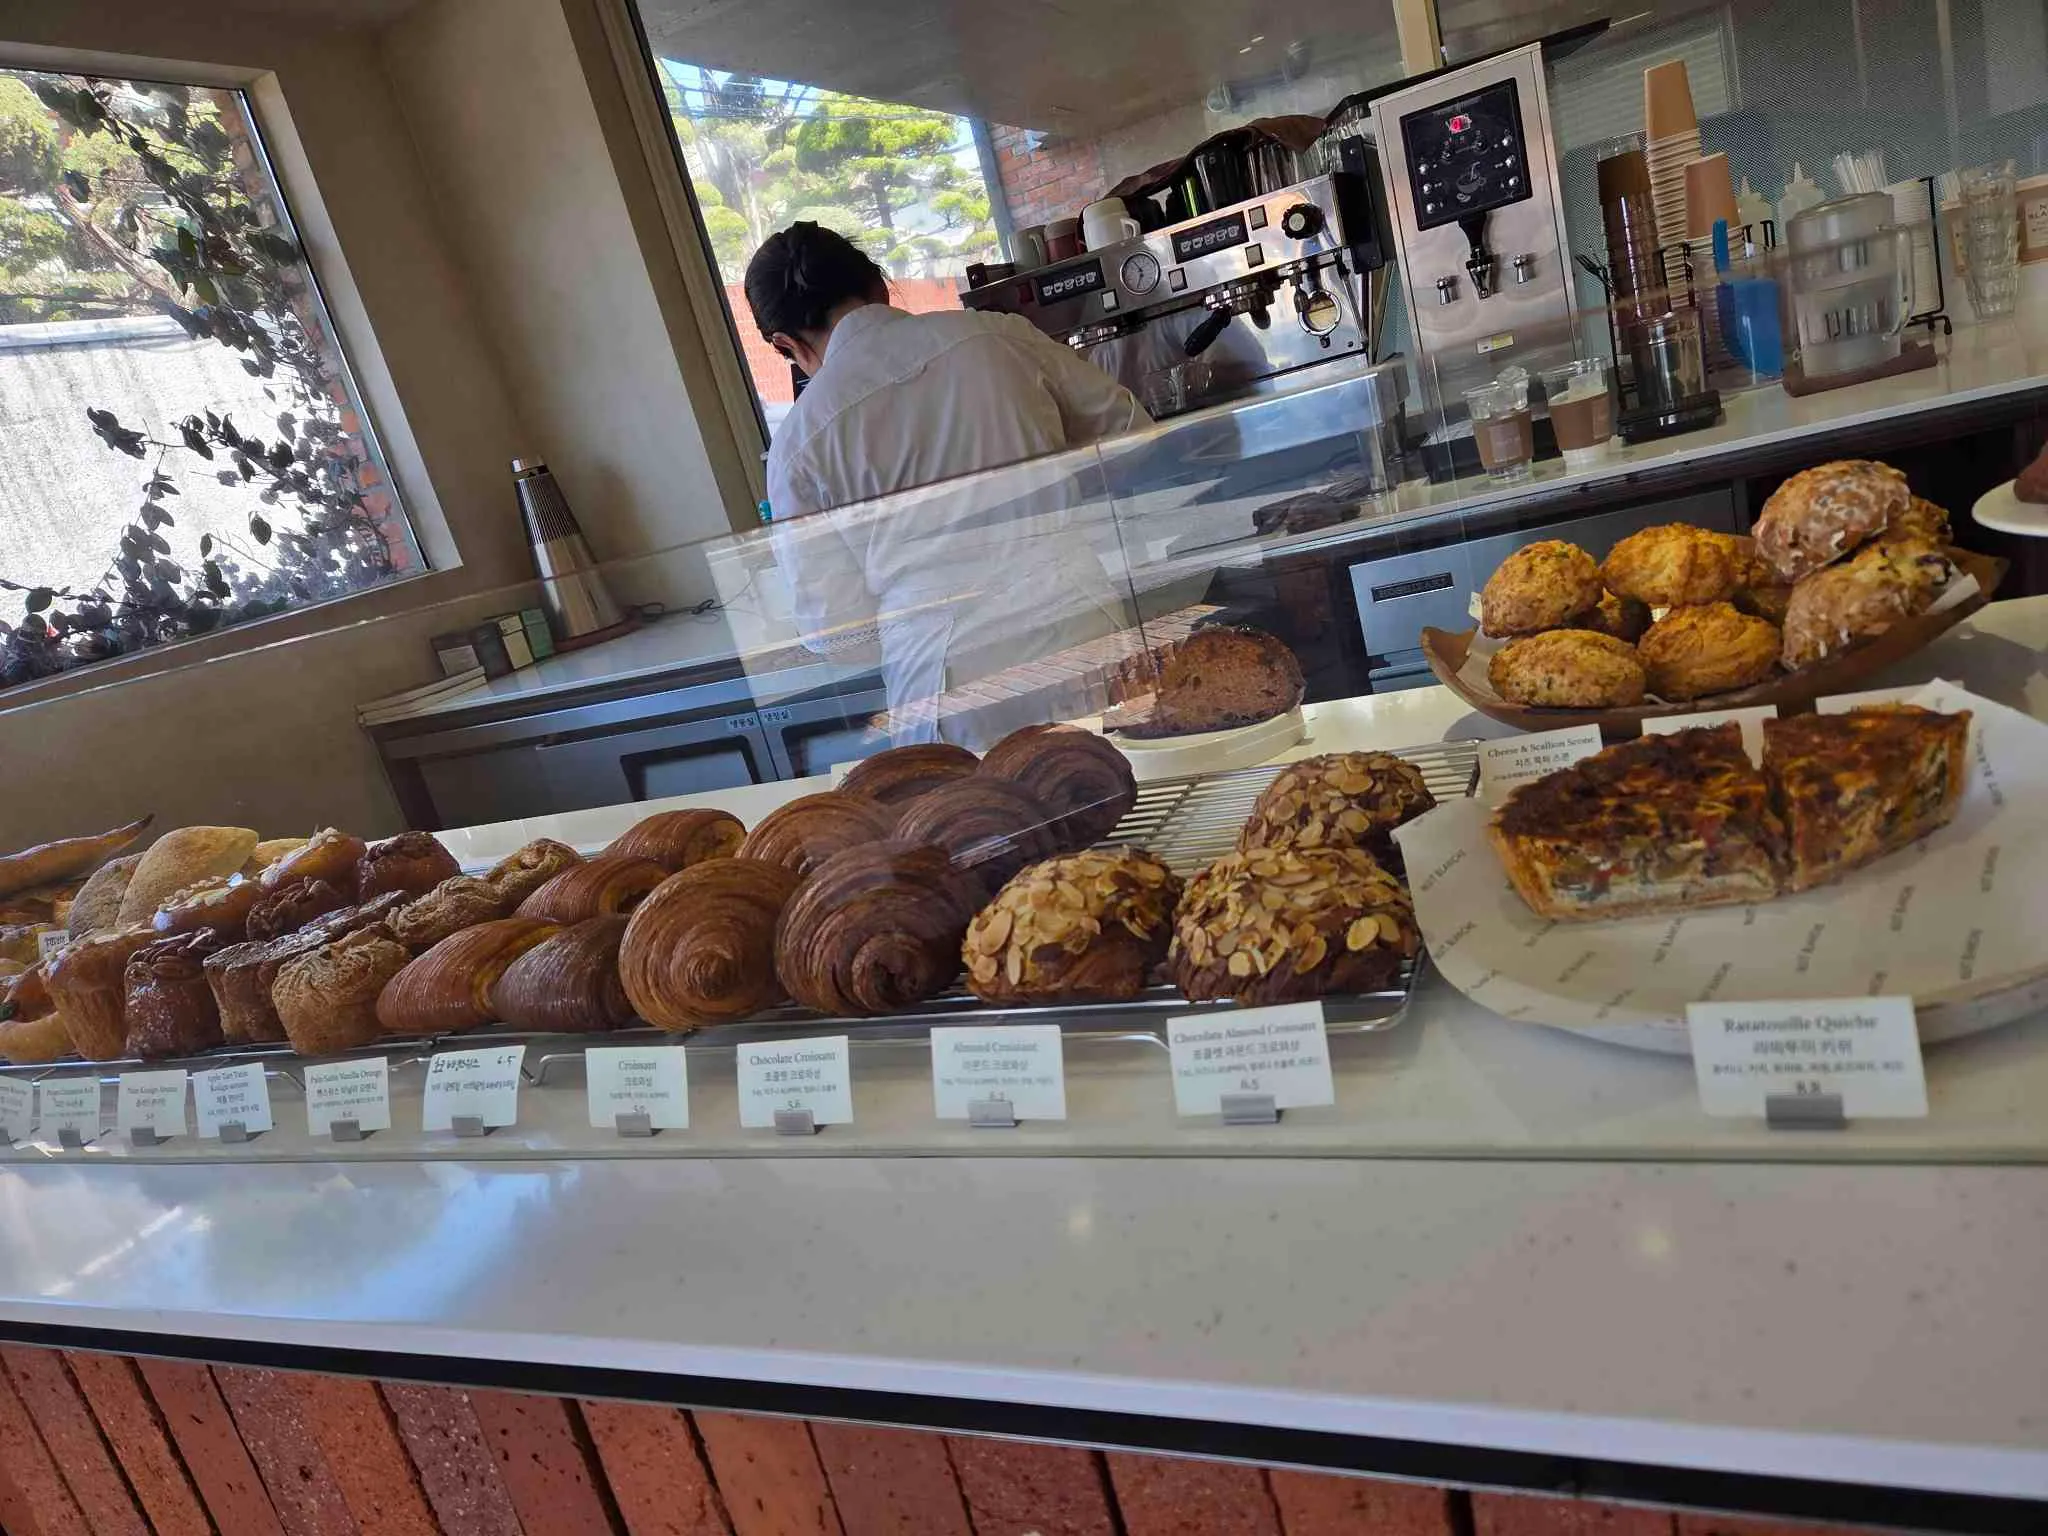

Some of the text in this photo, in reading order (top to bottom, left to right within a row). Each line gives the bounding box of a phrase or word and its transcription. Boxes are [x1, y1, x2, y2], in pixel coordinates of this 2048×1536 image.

[1174, 1021, 1317, 1044] Chocolate Almond Croissant
[1723, 1015, 1878, 1033] Ratatouille Quiche
[618, 1060, 657, 1071] Croissant
[750, 1050, 836, 1066] Chocolate Croissant
